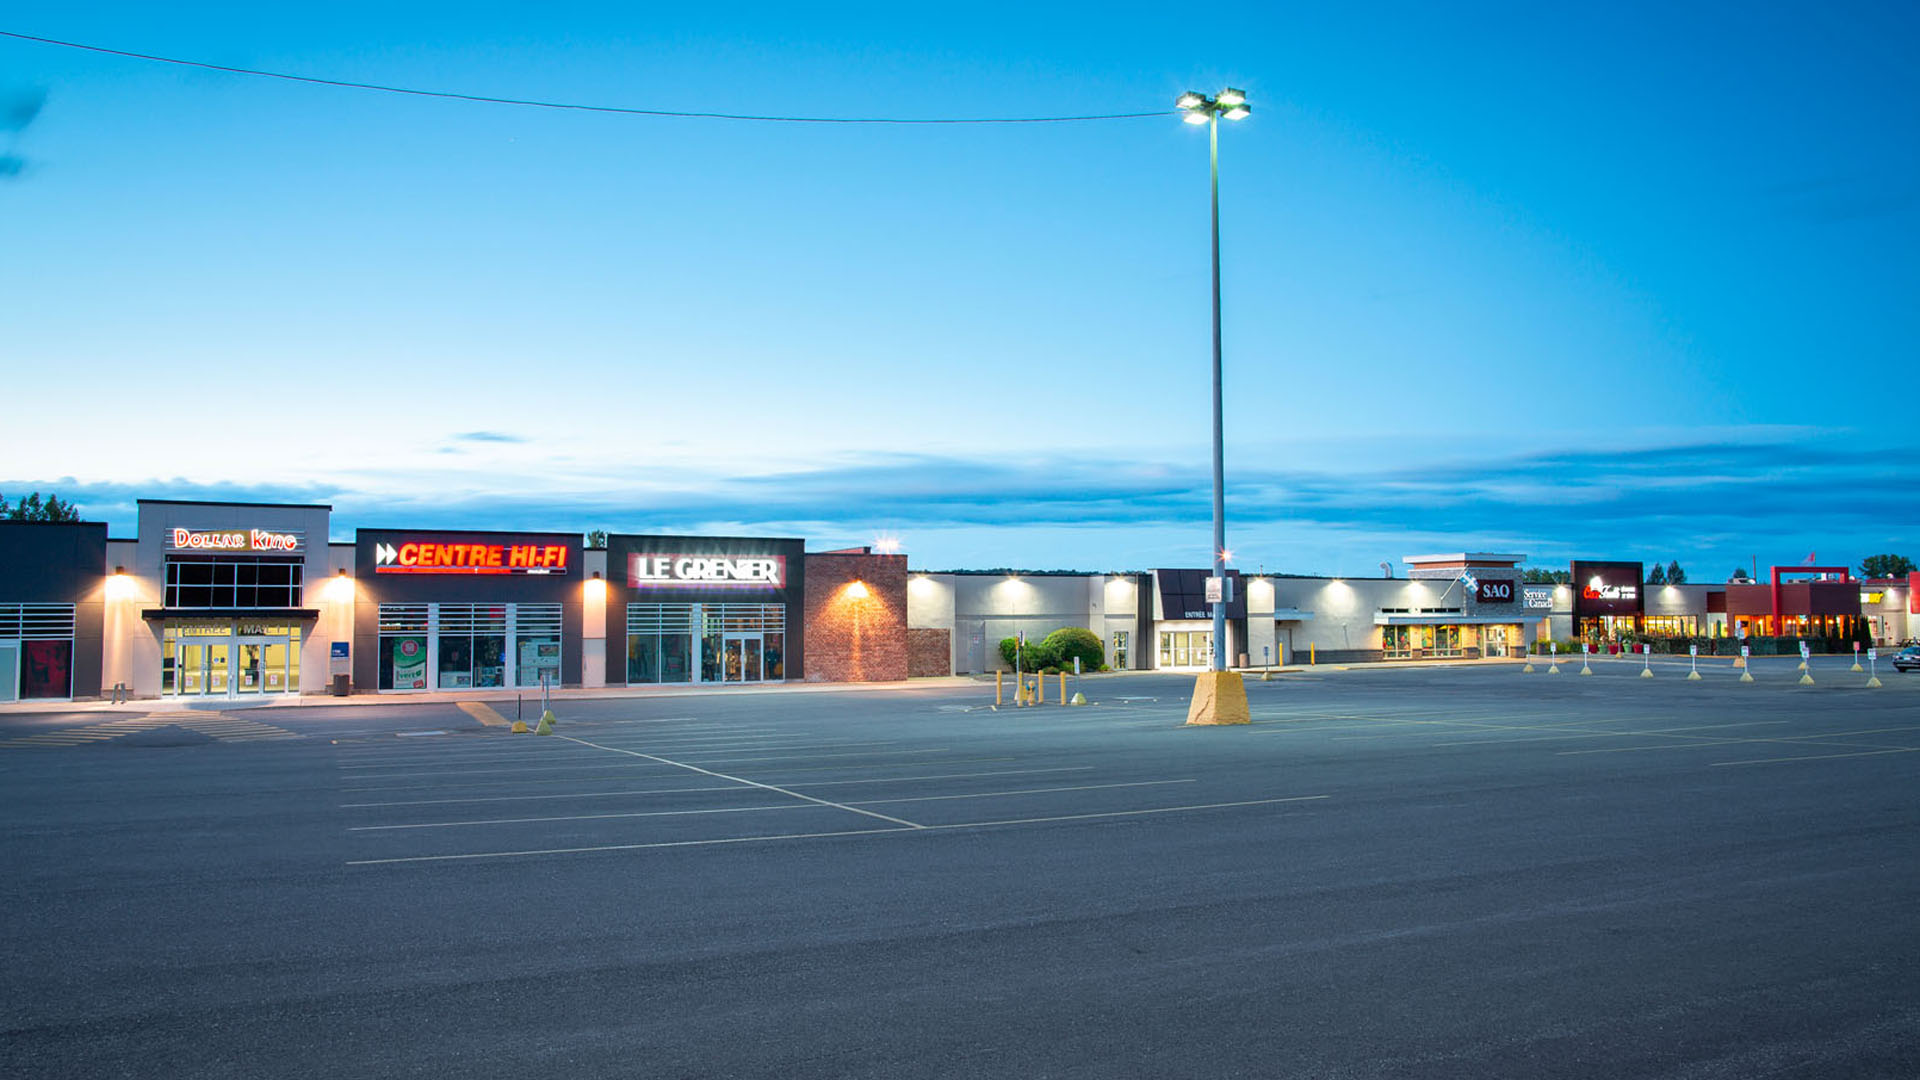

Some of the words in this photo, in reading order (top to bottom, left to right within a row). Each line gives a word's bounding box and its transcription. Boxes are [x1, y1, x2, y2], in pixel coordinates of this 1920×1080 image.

[174, 528, 245, 547] DOLLAR
[399, 543, 503, 567] CENTRE
[509, 545, 567, 567] HI-FI
[638, 557, 670, 579] LE
[674, 557, 780, 584] GRENIER
[1483, 584, 1510, 598] SAQ
[1523, 588, 1547, 600] Service
